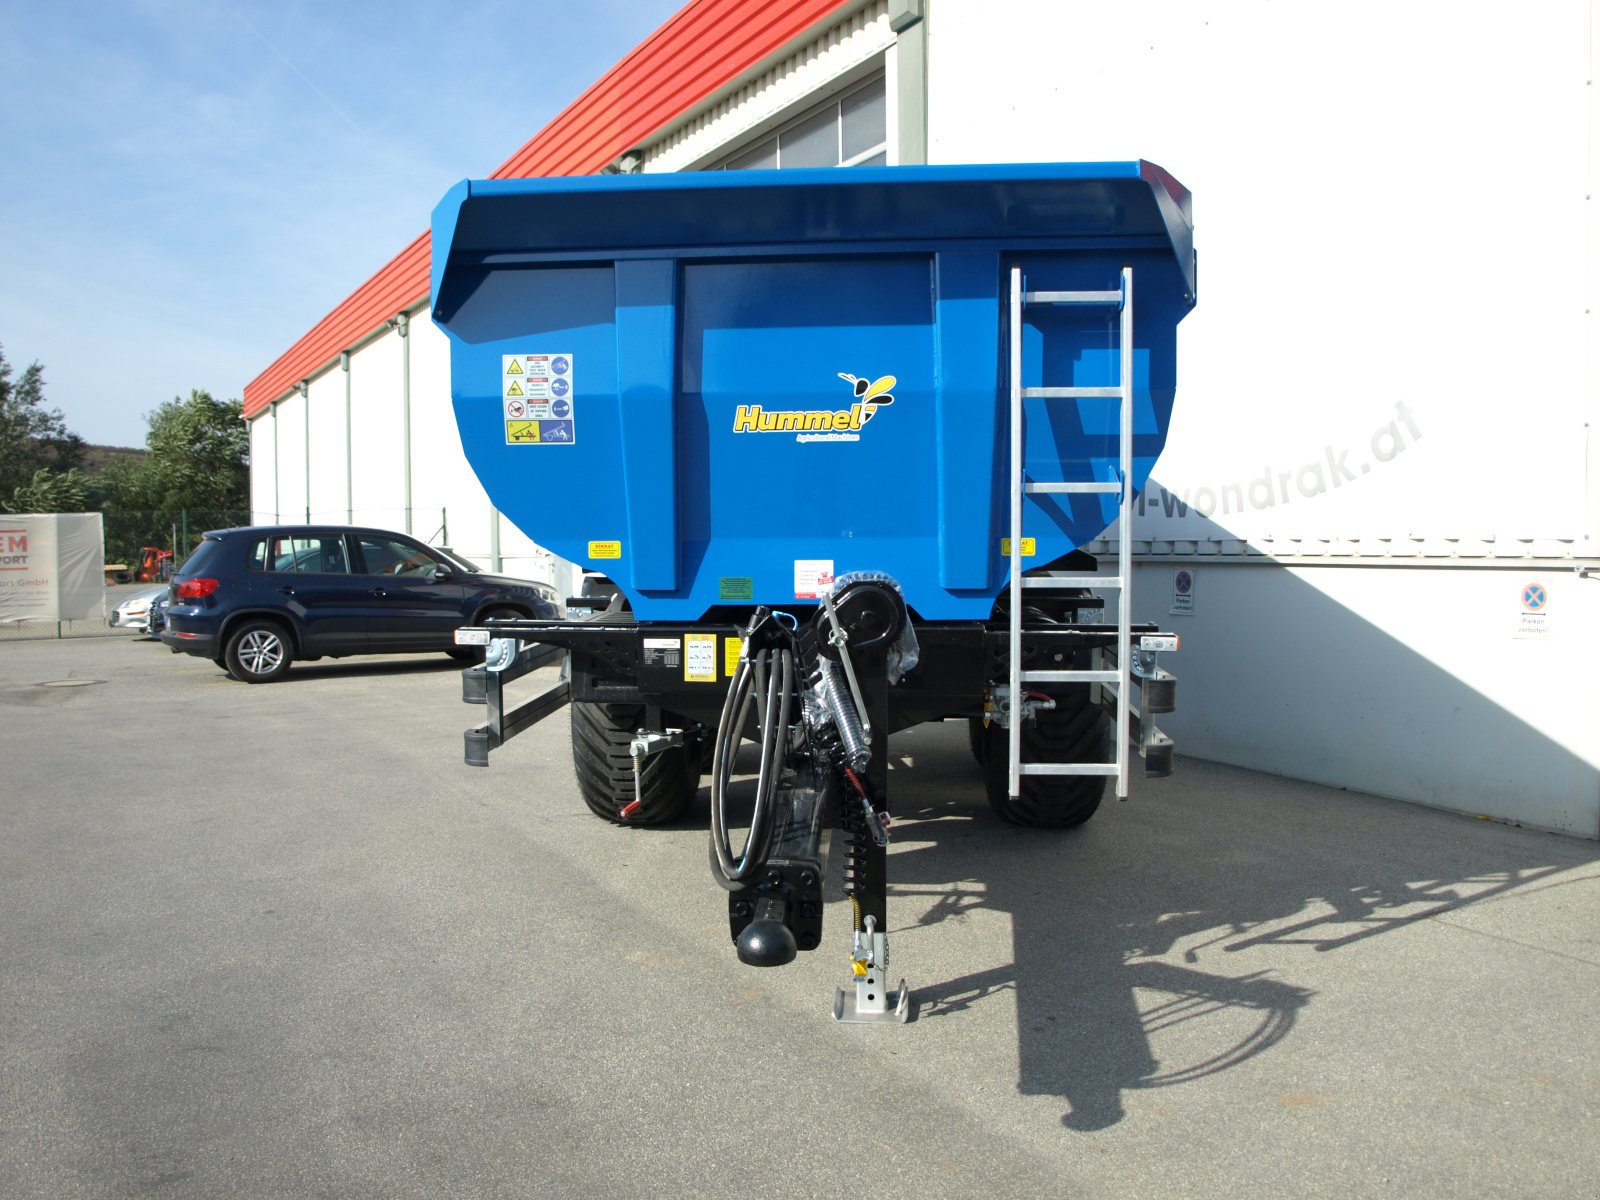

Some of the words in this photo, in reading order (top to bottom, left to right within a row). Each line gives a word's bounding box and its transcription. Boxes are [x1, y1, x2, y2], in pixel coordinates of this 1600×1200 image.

[734, 404, 862, 432] Hummel
[1138, 400, 1422, 518] l-wondrak.at
[0, 555, 28, 565] ORT
[17, 578, 48, 587] GmbH
[1522, 617, 1545, 625] Parken
